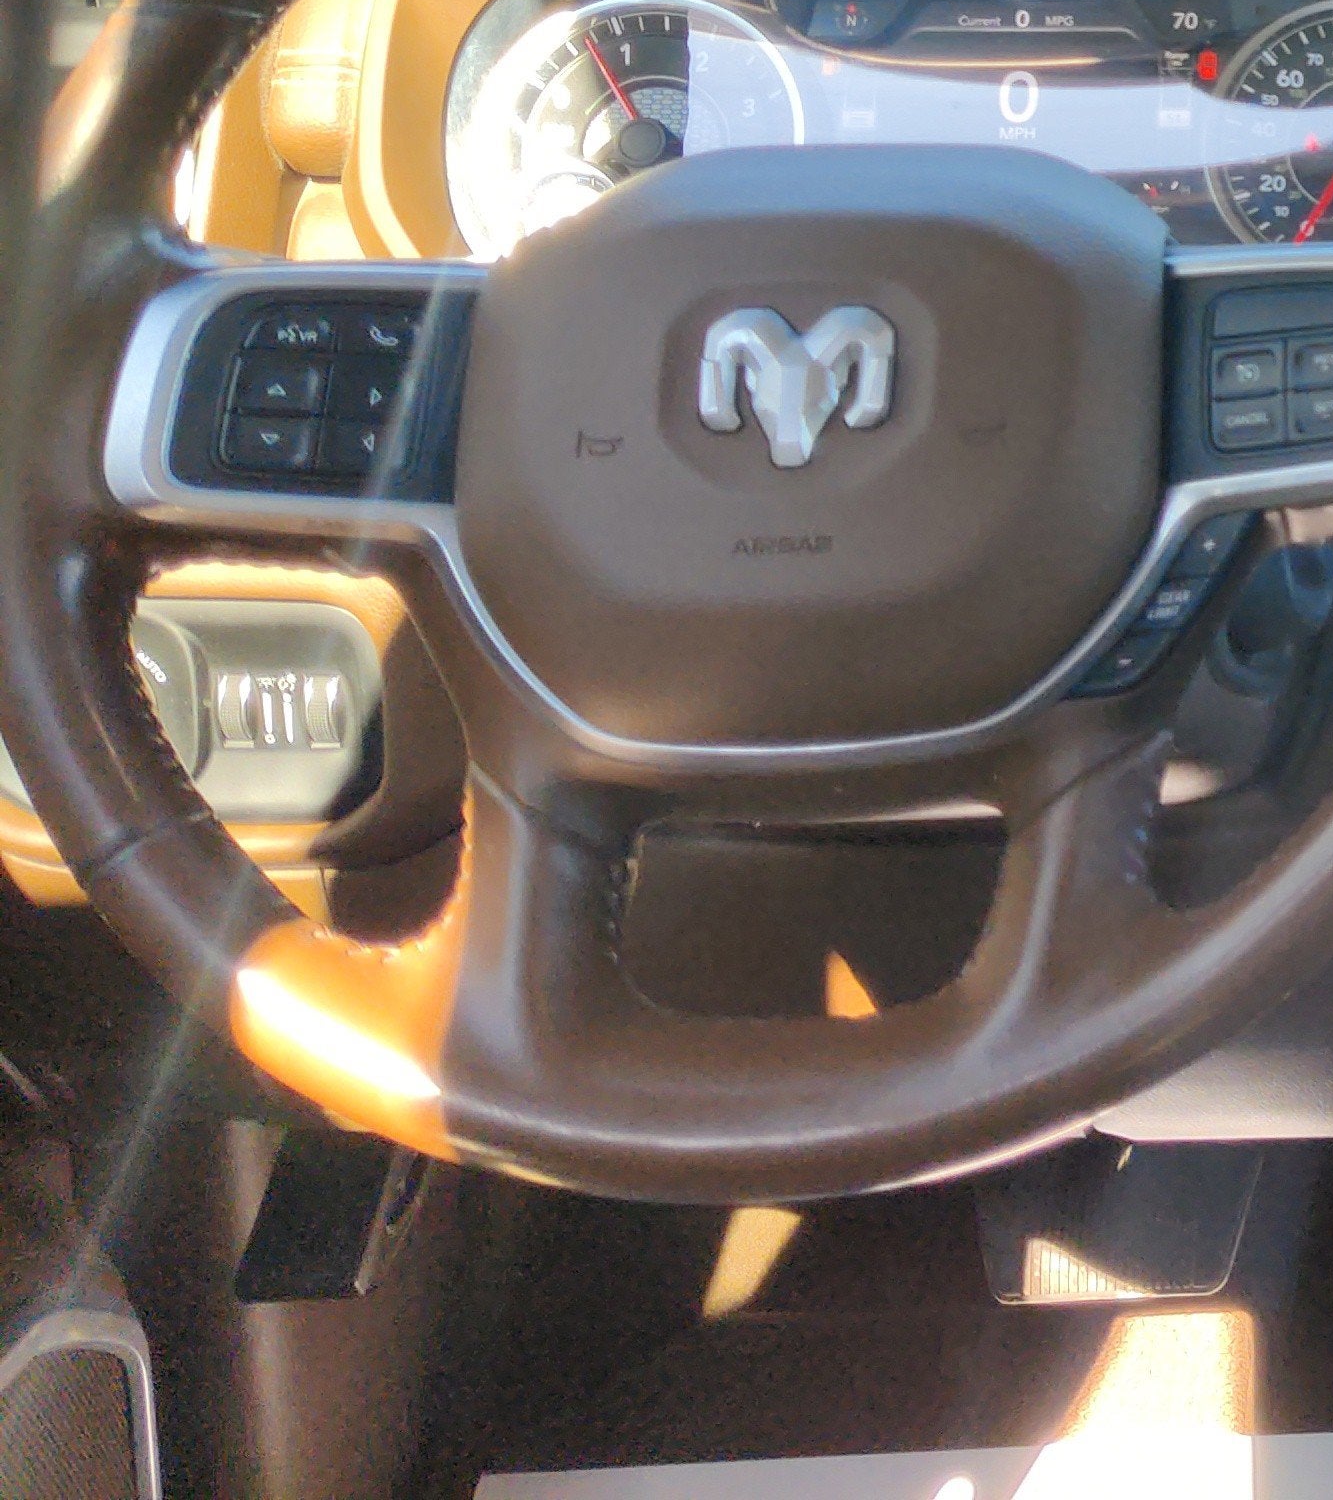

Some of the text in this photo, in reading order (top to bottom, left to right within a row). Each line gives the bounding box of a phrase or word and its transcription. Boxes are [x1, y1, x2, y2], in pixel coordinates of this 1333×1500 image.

[846, 14, 857, 27] N
[958, 9, 1074, 29] Current 0 MPG
[1171, 12, 1199, 30] 70
[620, 43, 631, 66] 1
[695, 52, 709, 73] 2
[1276, 69, 1304, 88] 60
[1000, 71, 1040, 123] 0
[743, 99, 755, 117] 3
[1000, 127, 1036, 140] MPH
[1259, 175, 1286, 192] 20
[136, 650, 167, 683] AUTO
